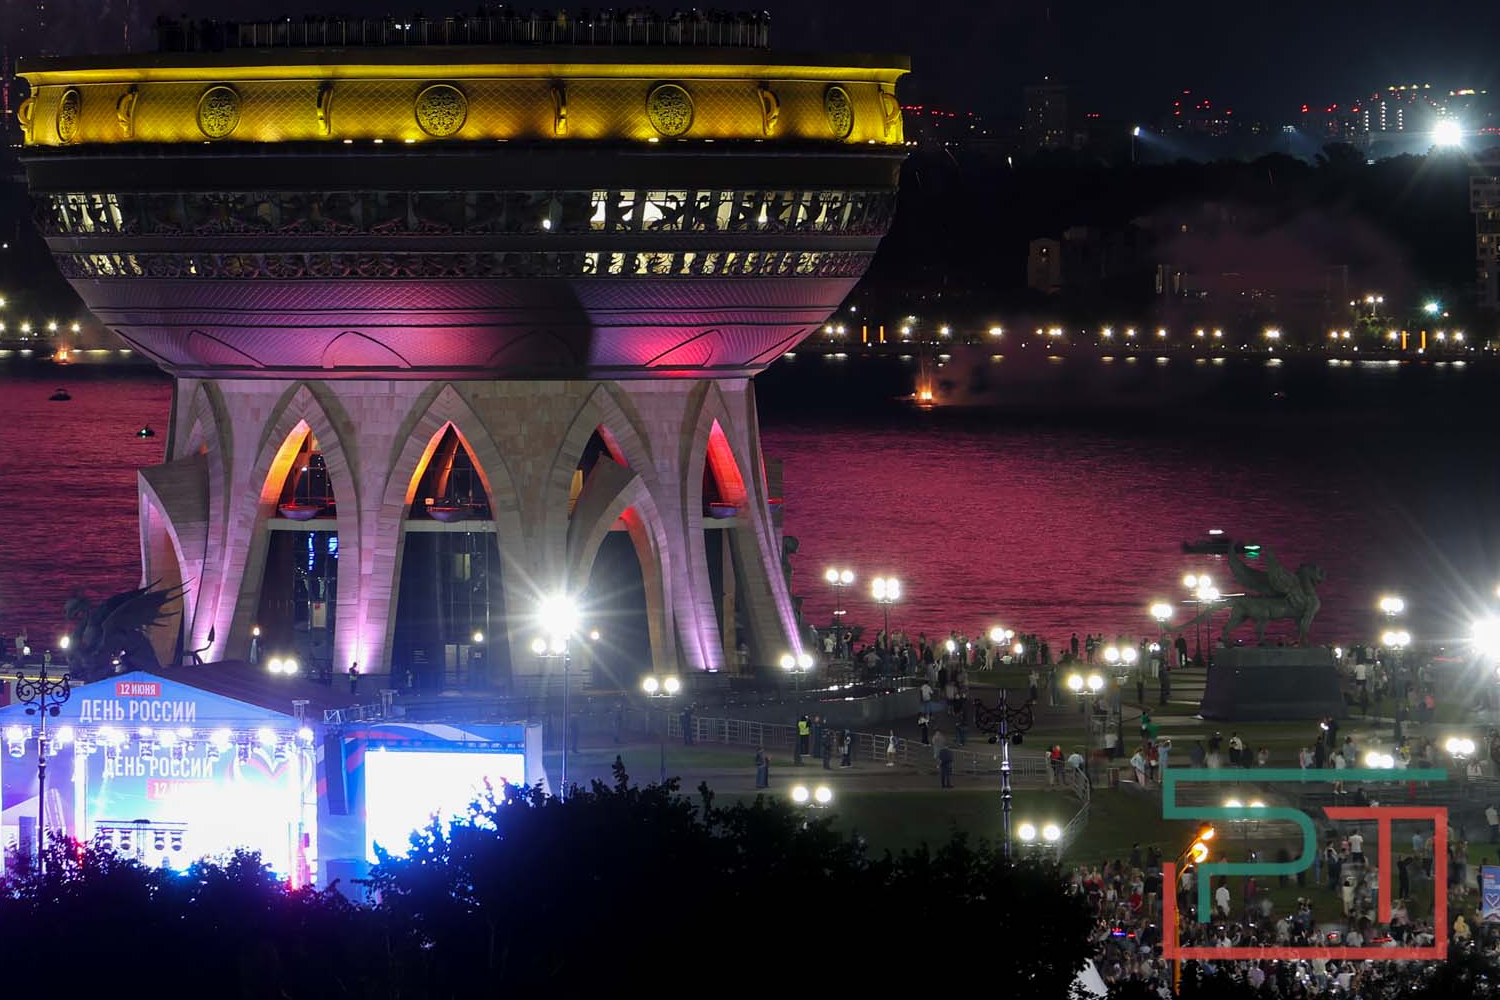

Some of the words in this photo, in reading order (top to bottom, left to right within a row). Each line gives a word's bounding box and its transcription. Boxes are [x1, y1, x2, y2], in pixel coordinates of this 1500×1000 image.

[120, 684, 130, 695] 12
[131, 684, 156, 695] ИЮНЯ
[79, 700, 125, 723] ДЕНЬ
[129, 700, 196, 722] РОССИИ
[103, 756, 145, 778] ДЕНЬ
[150, 756, 213, 777] РОССИИ
